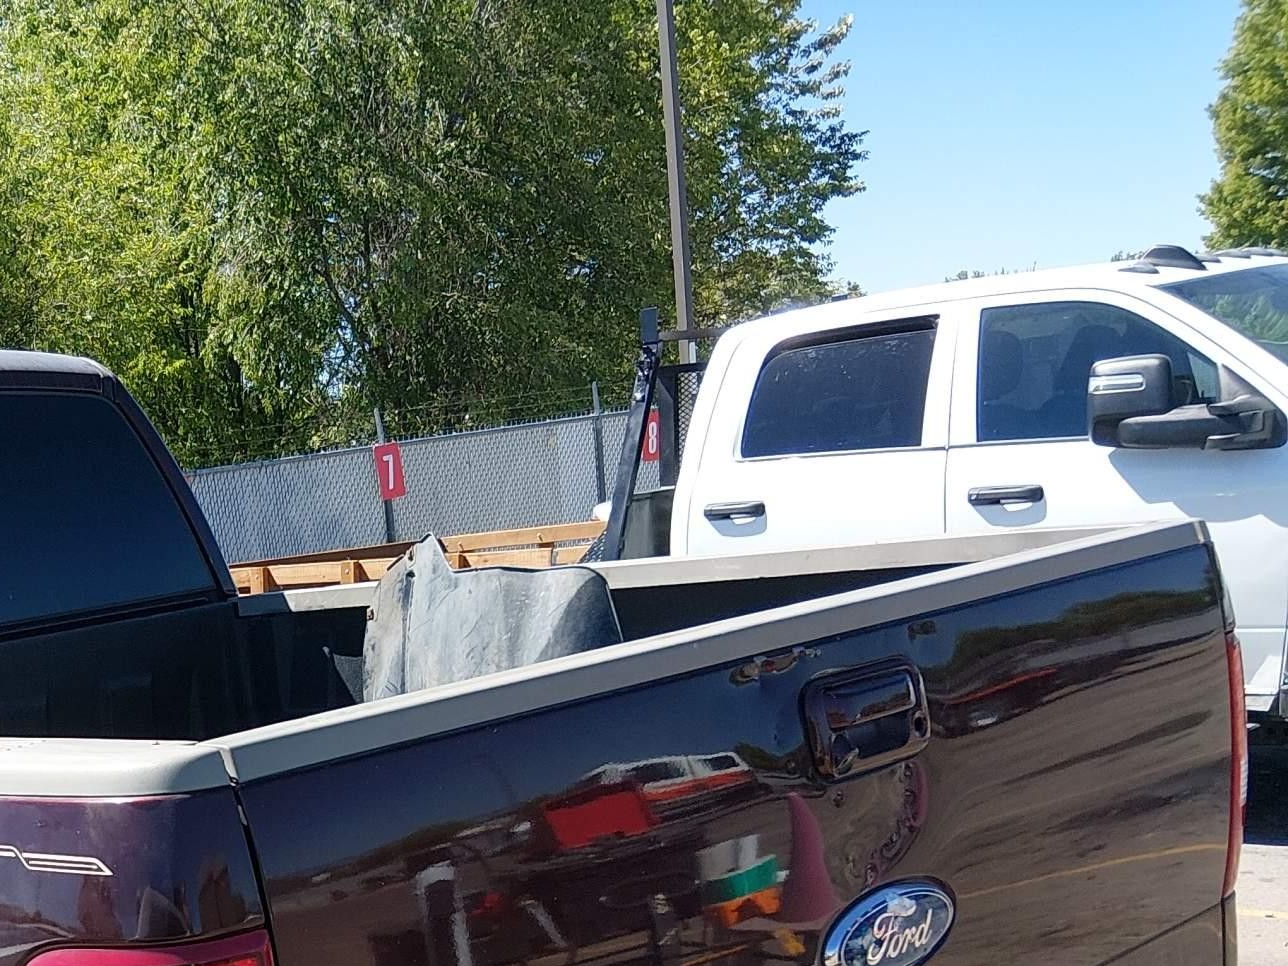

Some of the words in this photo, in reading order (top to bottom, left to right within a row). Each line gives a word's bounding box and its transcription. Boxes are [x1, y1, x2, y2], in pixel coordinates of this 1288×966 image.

[648, 422, 657, 454] 8
[383, 454, 394, 490] 7
[866, 902, 933, 966] Ford
